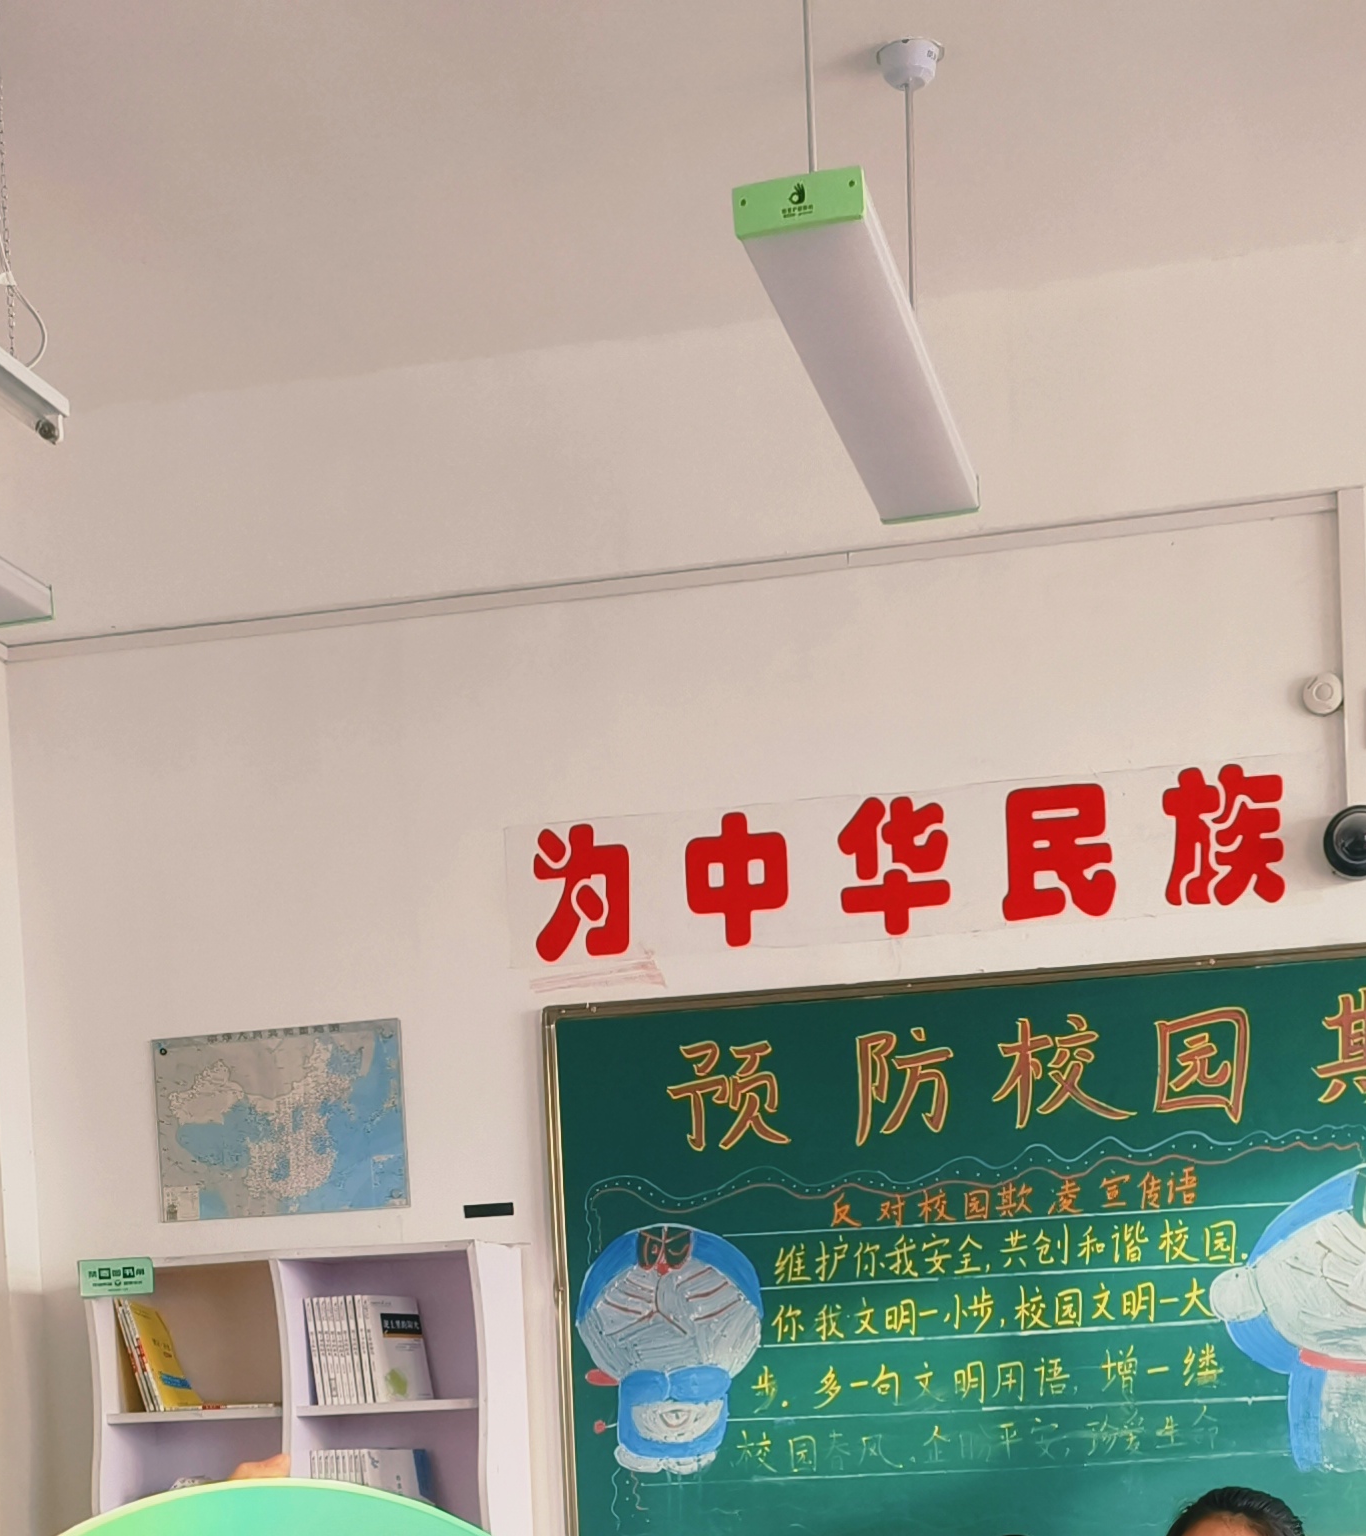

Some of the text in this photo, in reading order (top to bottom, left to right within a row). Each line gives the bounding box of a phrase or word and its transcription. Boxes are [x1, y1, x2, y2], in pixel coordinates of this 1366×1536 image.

[830, 1163, 1199, 1229] 反对校园欺凌宣传语
